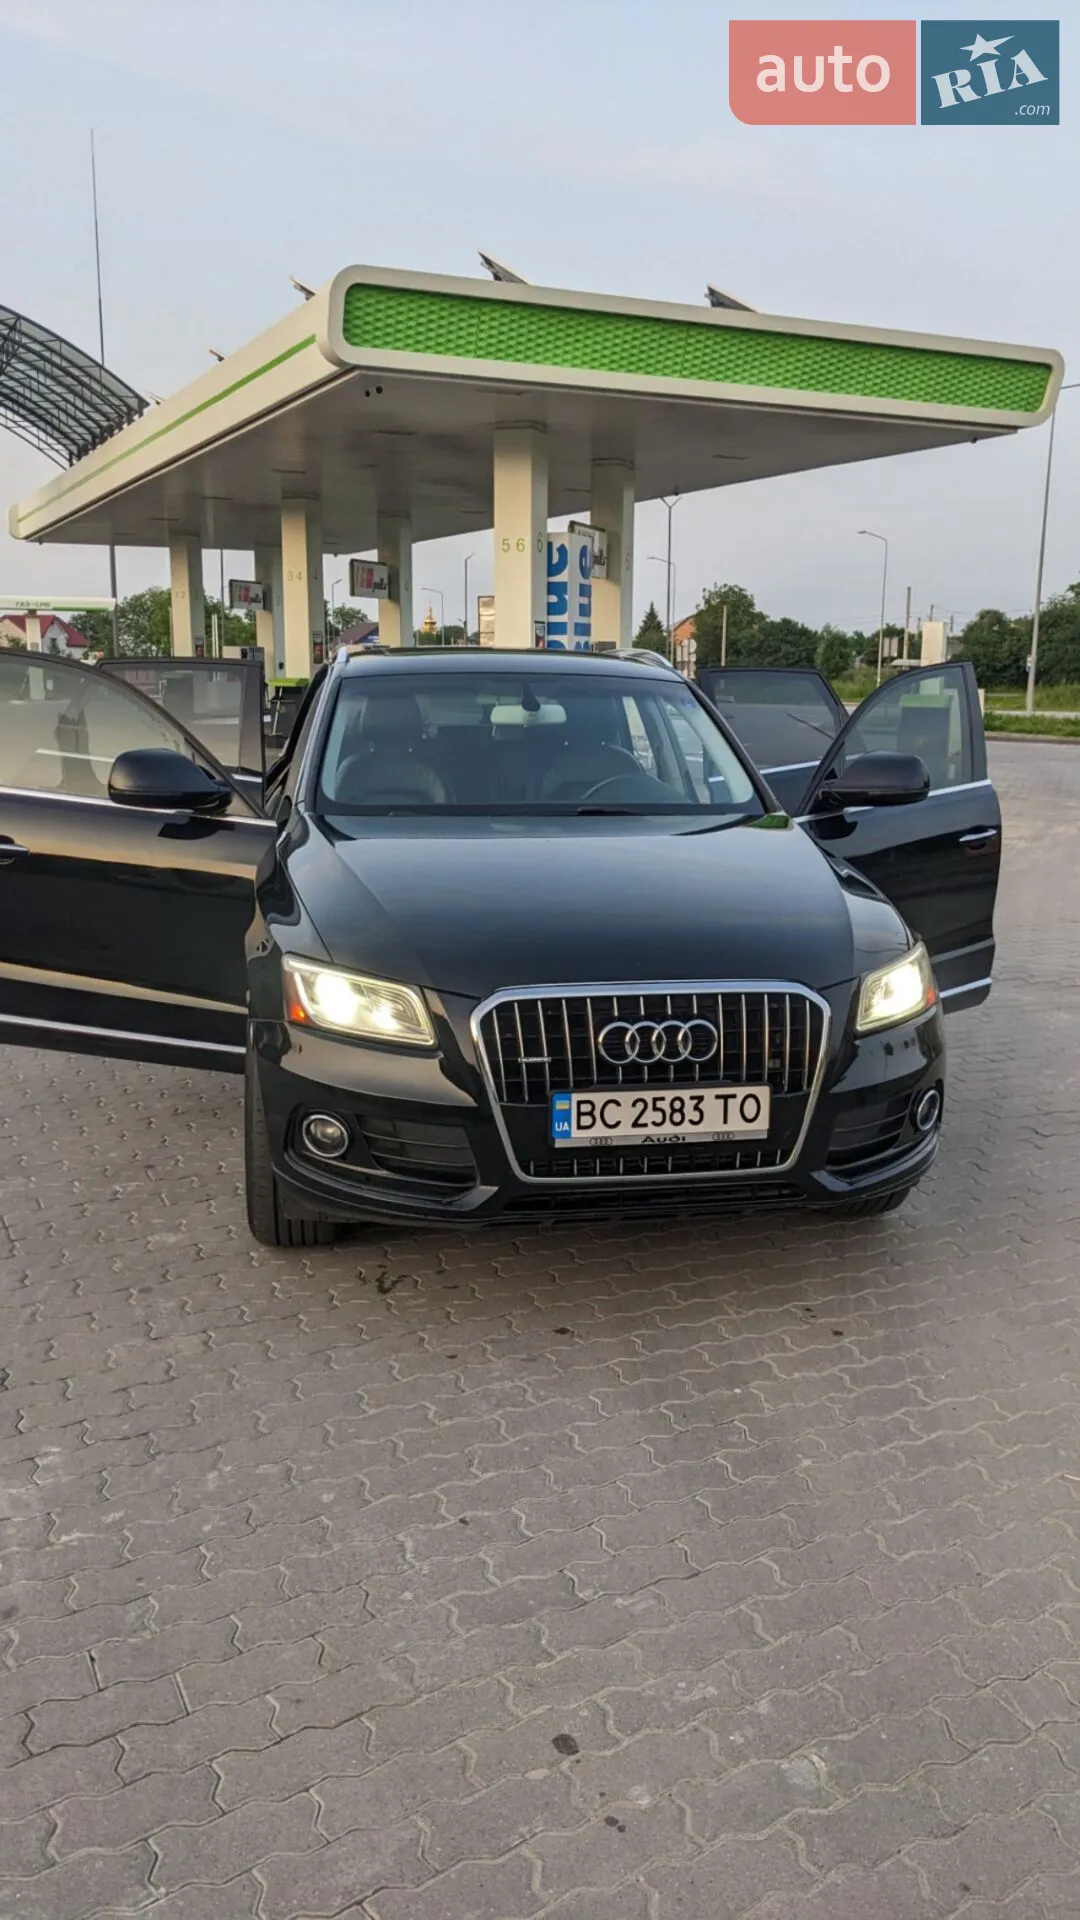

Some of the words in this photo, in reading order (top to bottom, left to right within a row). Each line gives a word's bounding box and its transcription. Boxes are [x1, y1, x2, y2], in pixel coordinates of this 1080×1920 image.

[501, 538, 511, 553] 5
[516, 538, 526, 553] 6
[576, 1098, 622, 1131] BC
[631, 1095, 705, 1128] 2583
[715, 1093, 762, 1125] TO
[555, 1121, 570, 1132] UA
[641, 1134, 687, 1144] Audi
